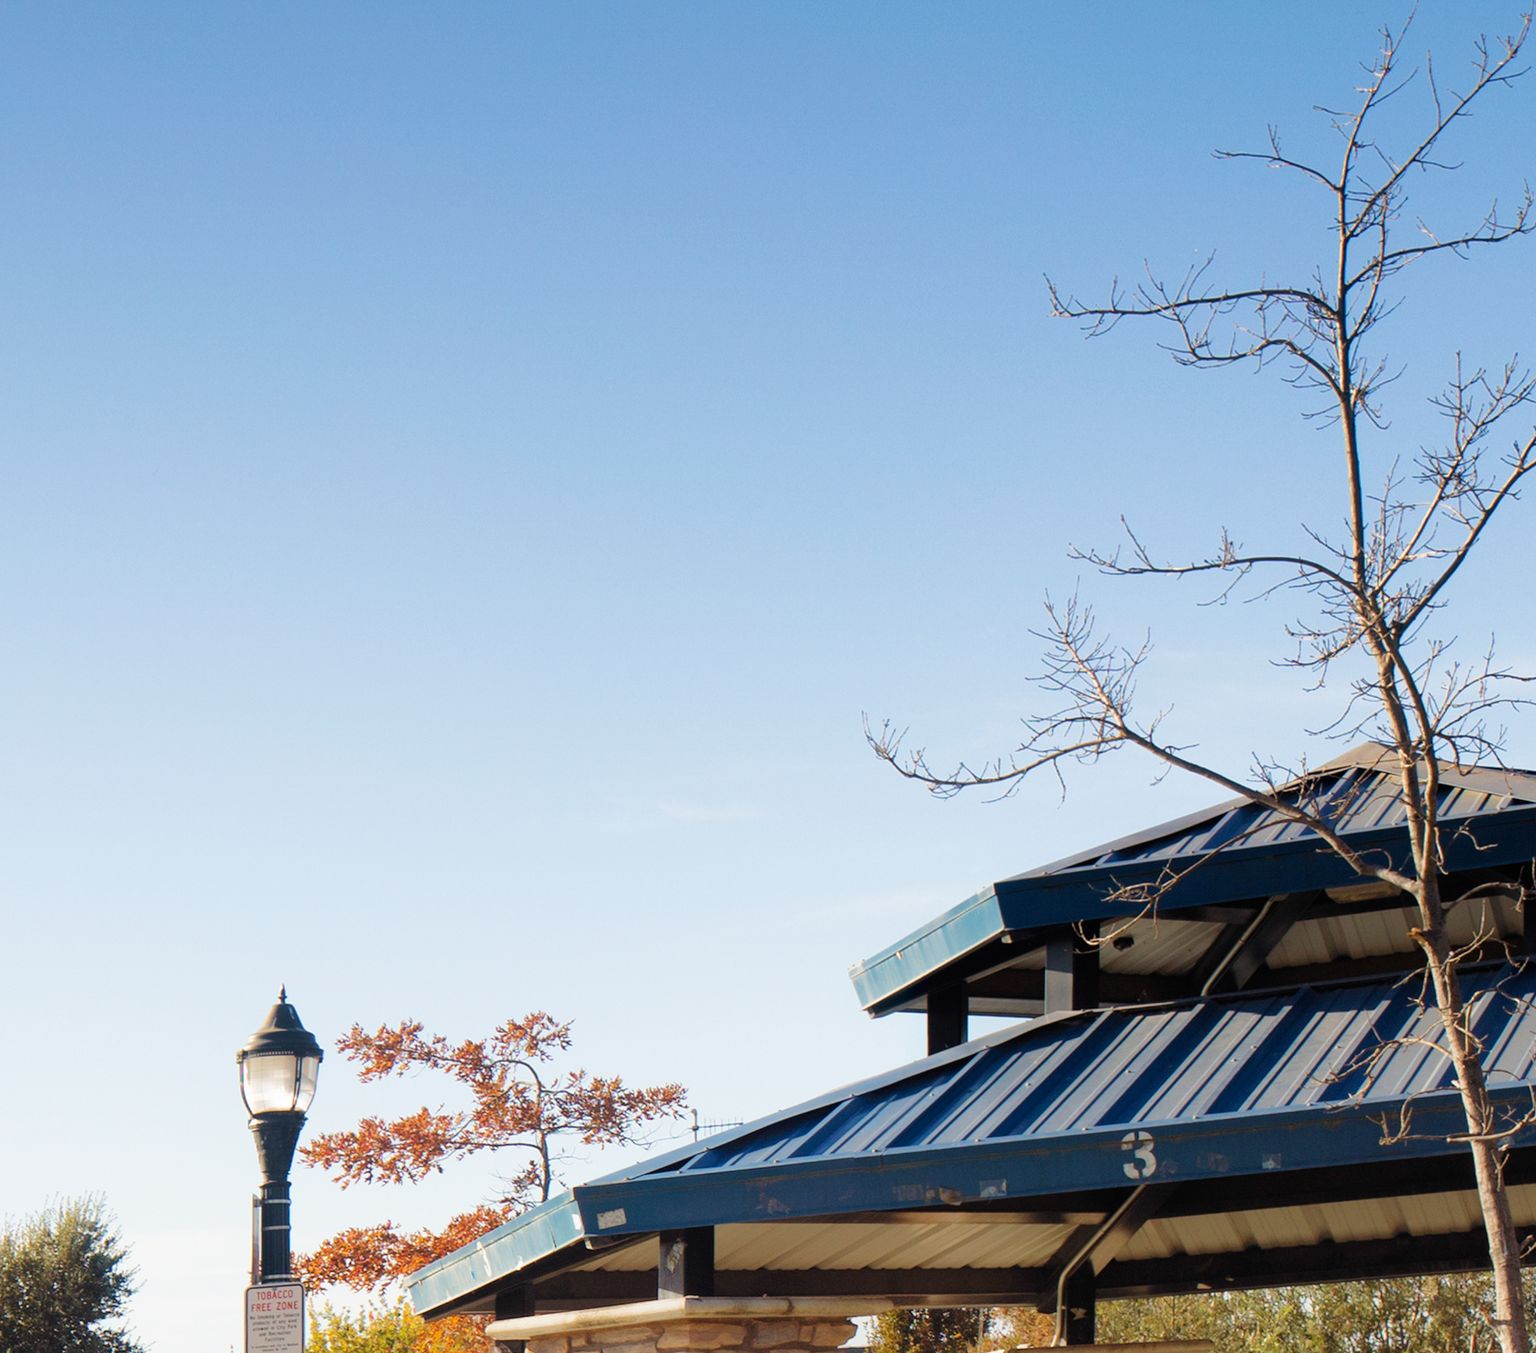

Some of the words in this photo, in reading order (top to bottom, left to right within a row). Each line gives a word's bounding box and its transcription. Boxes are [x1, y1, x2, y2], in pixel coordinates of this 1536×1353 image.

[1121, 1131, 1157, 1179] 3
[257, 1290, 293, 1300] TOBACCO
[251, 1303, 272, 1312] FREE
[276, 1301, 298, 1311] ZONE
